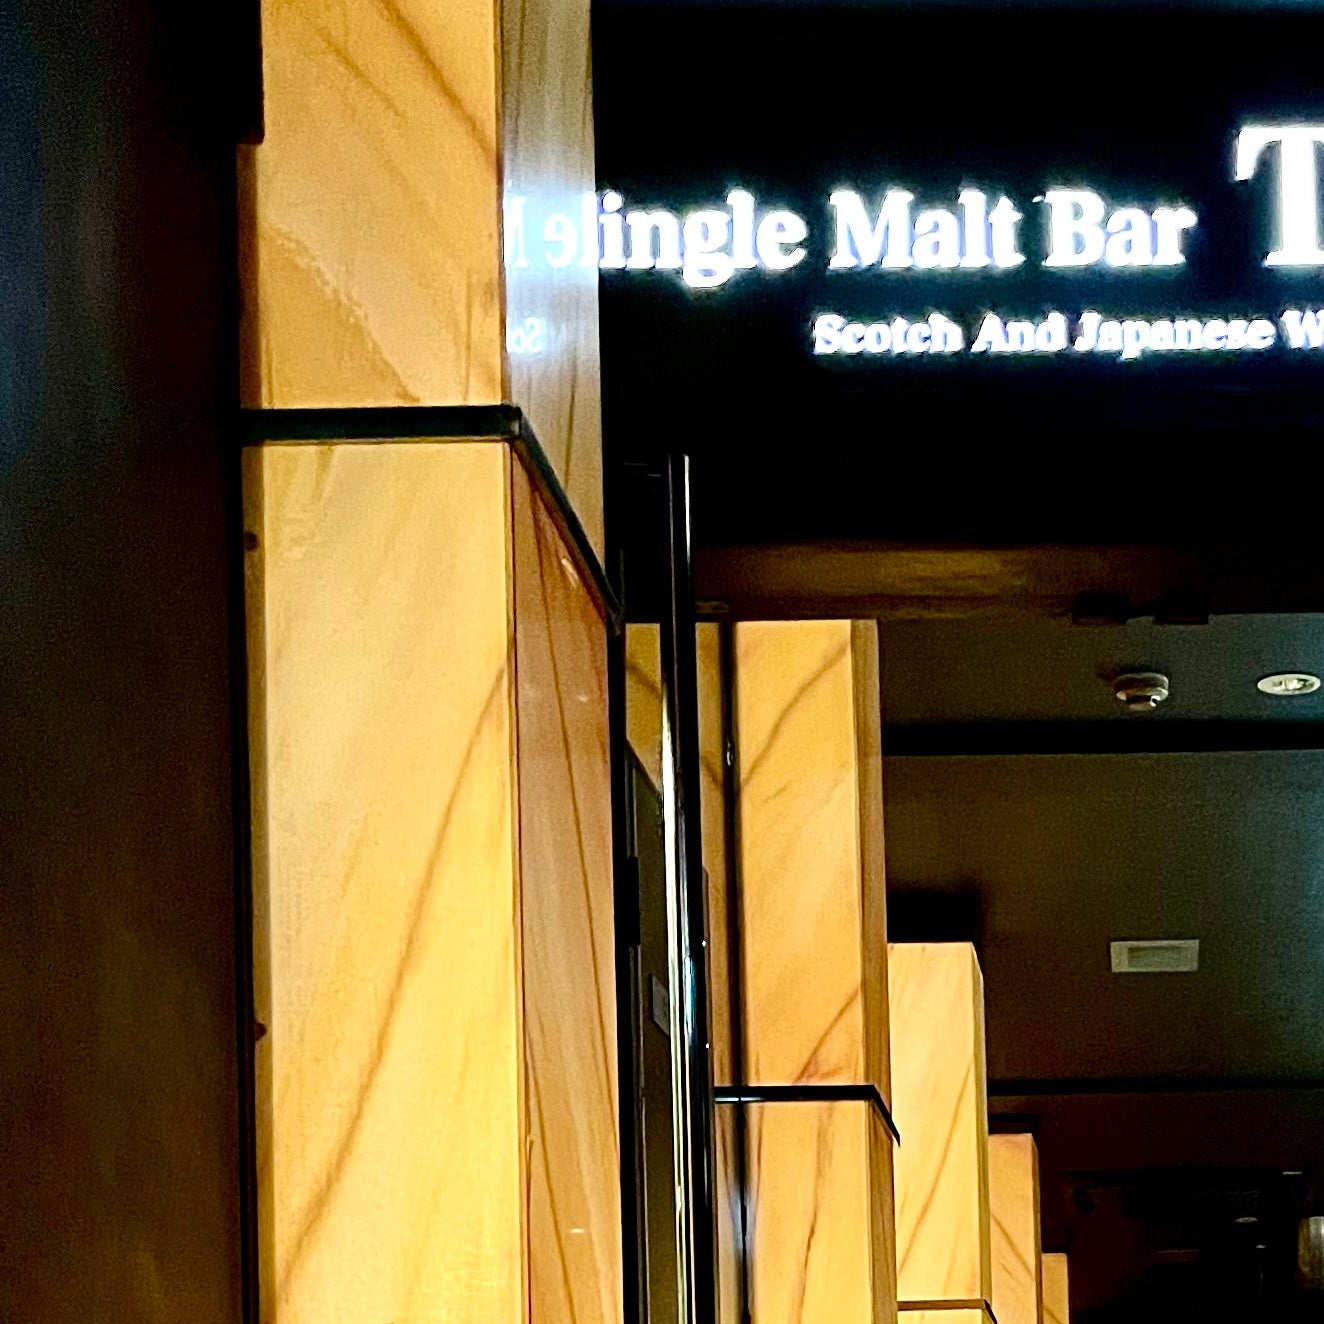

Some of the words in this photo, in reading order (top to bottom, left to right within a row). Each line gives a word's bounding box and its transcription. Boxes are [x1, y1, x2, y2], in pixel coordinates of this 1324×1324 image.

[599, 188, 808, 290] ingle
[827, 187, 1025, 270] Malt
[1033, 186, 1197, 268] Bar
[813, 312, 964, 354] Scotch
[970, 311, 1067, 353] And
[1073, 311, 1276, 360] Japanese
